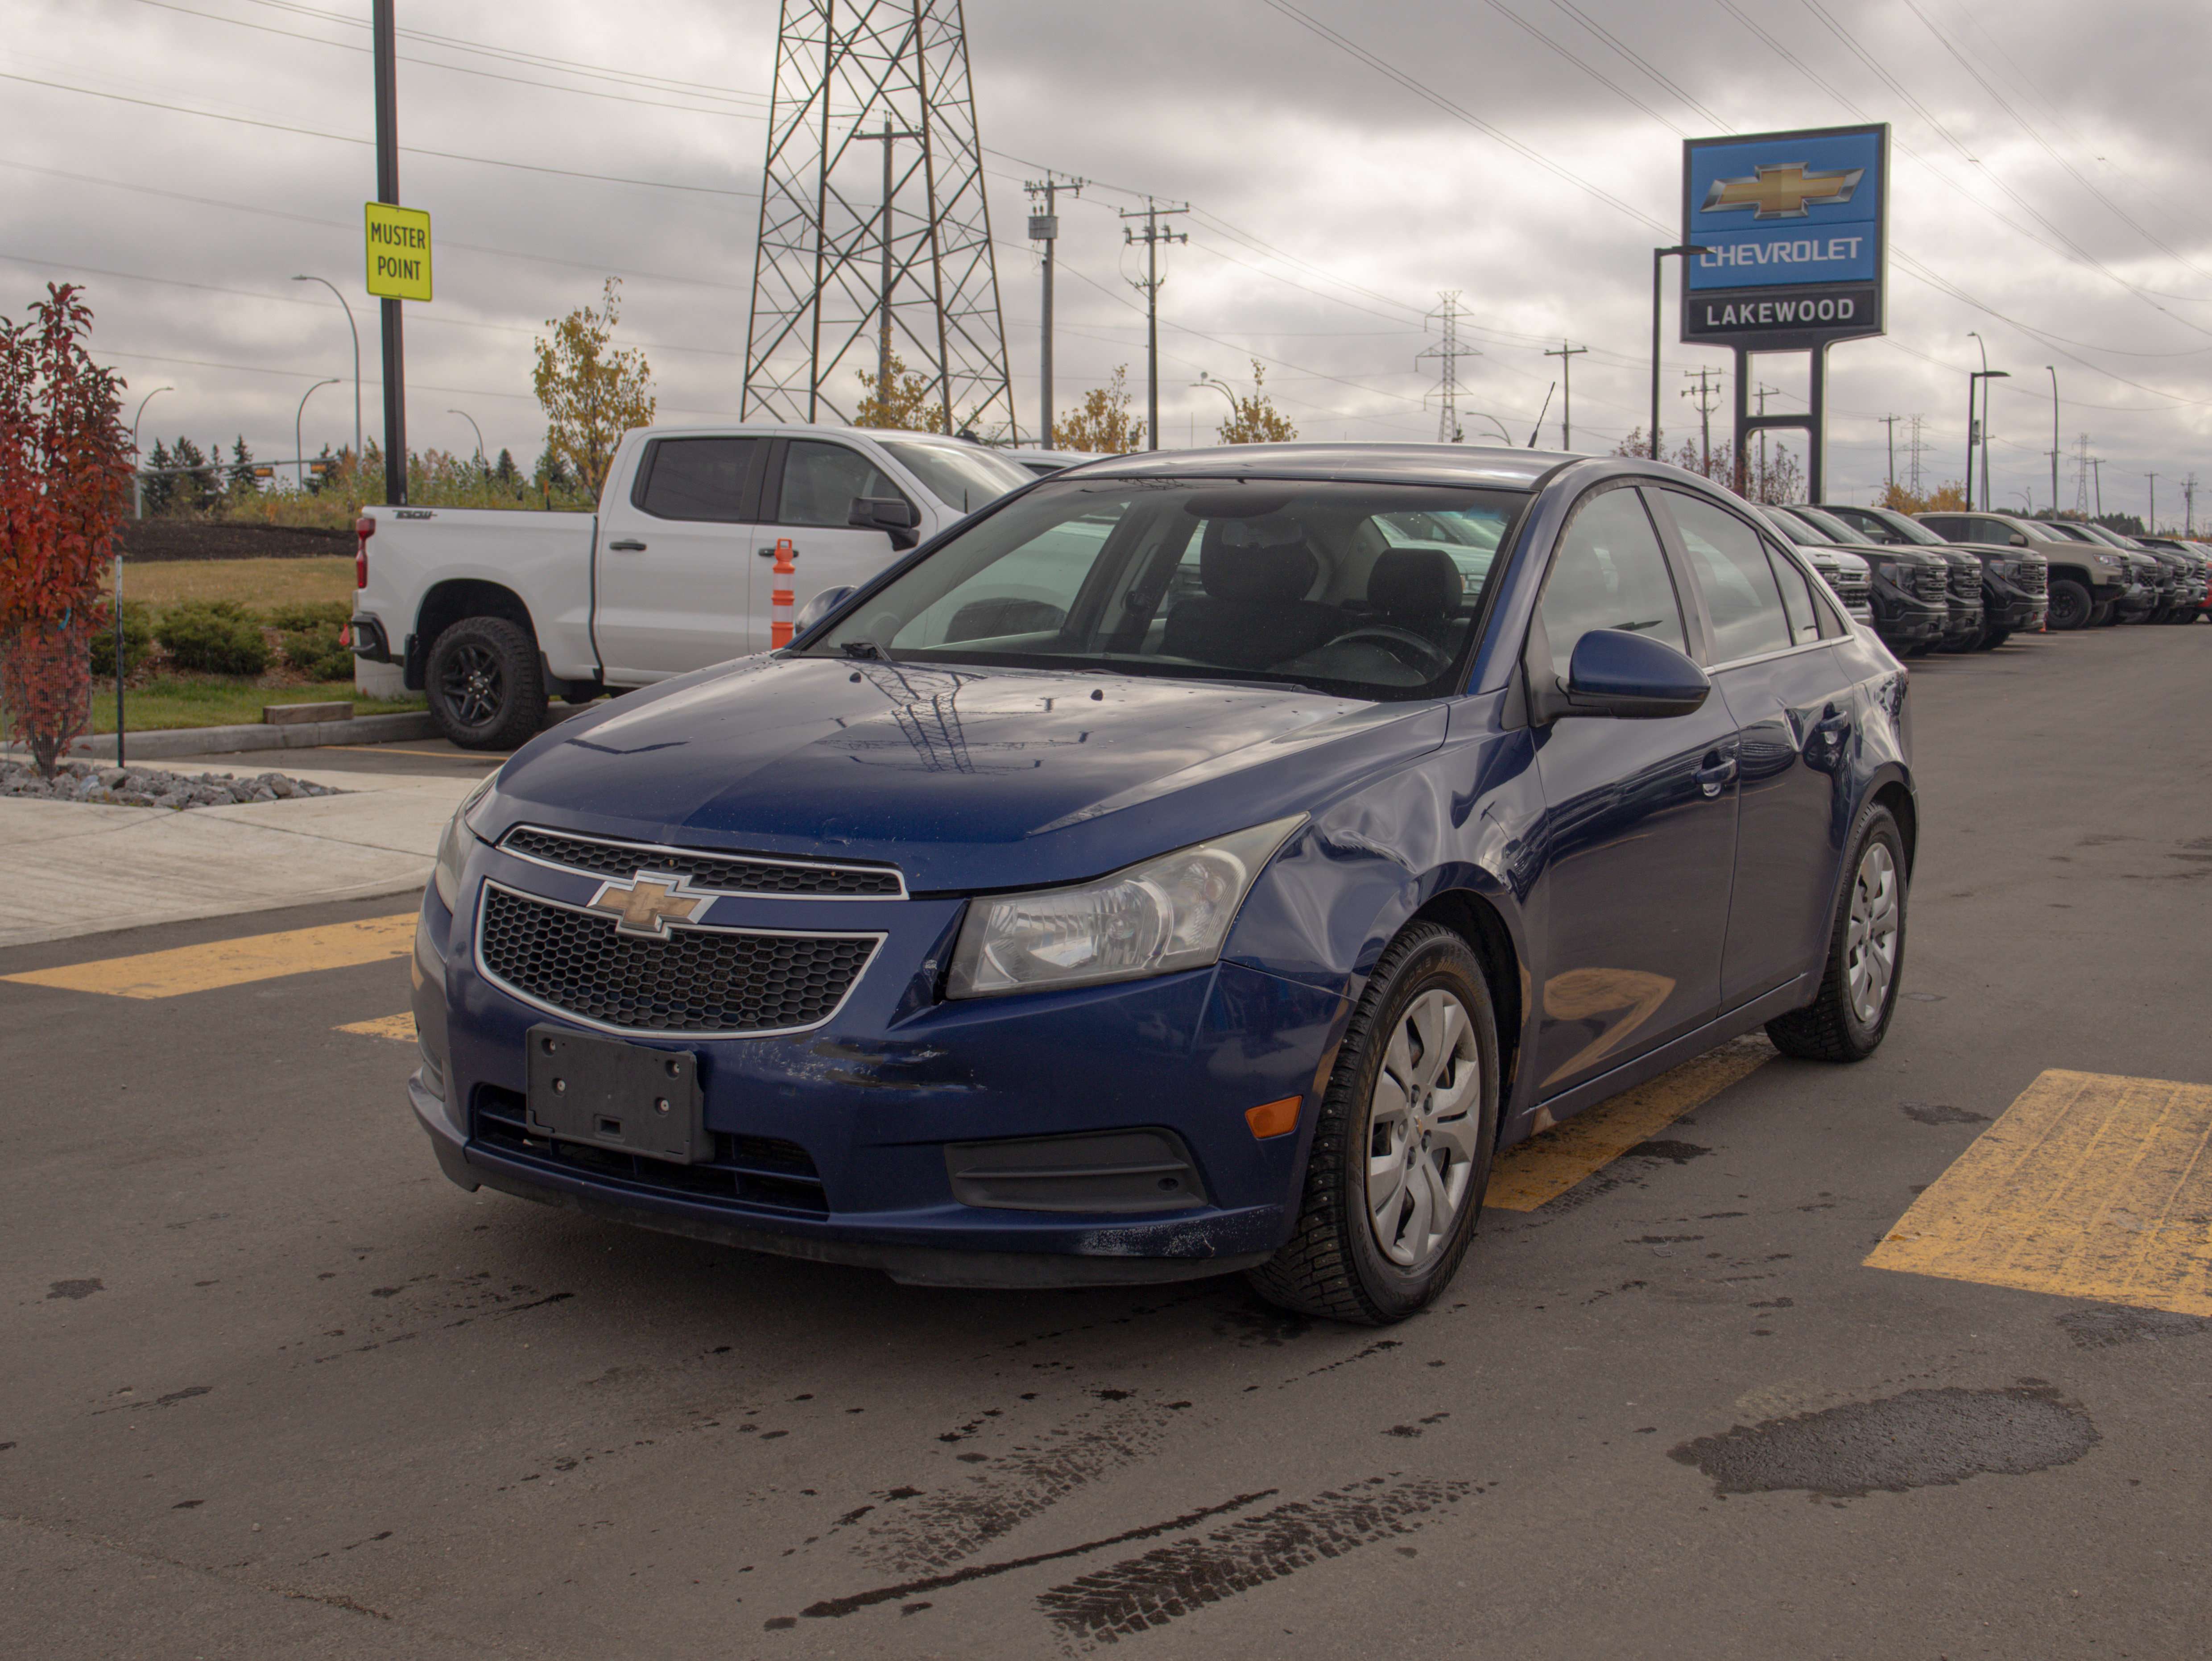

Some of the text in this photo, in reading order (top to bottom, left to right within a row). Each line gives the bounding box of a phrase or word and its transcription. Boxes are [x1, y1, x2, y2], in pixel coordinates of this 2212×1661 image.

[371, 222, 426, 249] MUSTER
[1700, 237, 1862, 267] CHEVROLET
[378, 256, 421, 281] POINT
[1706, 298, 1854, 326] LAKEWOOD
